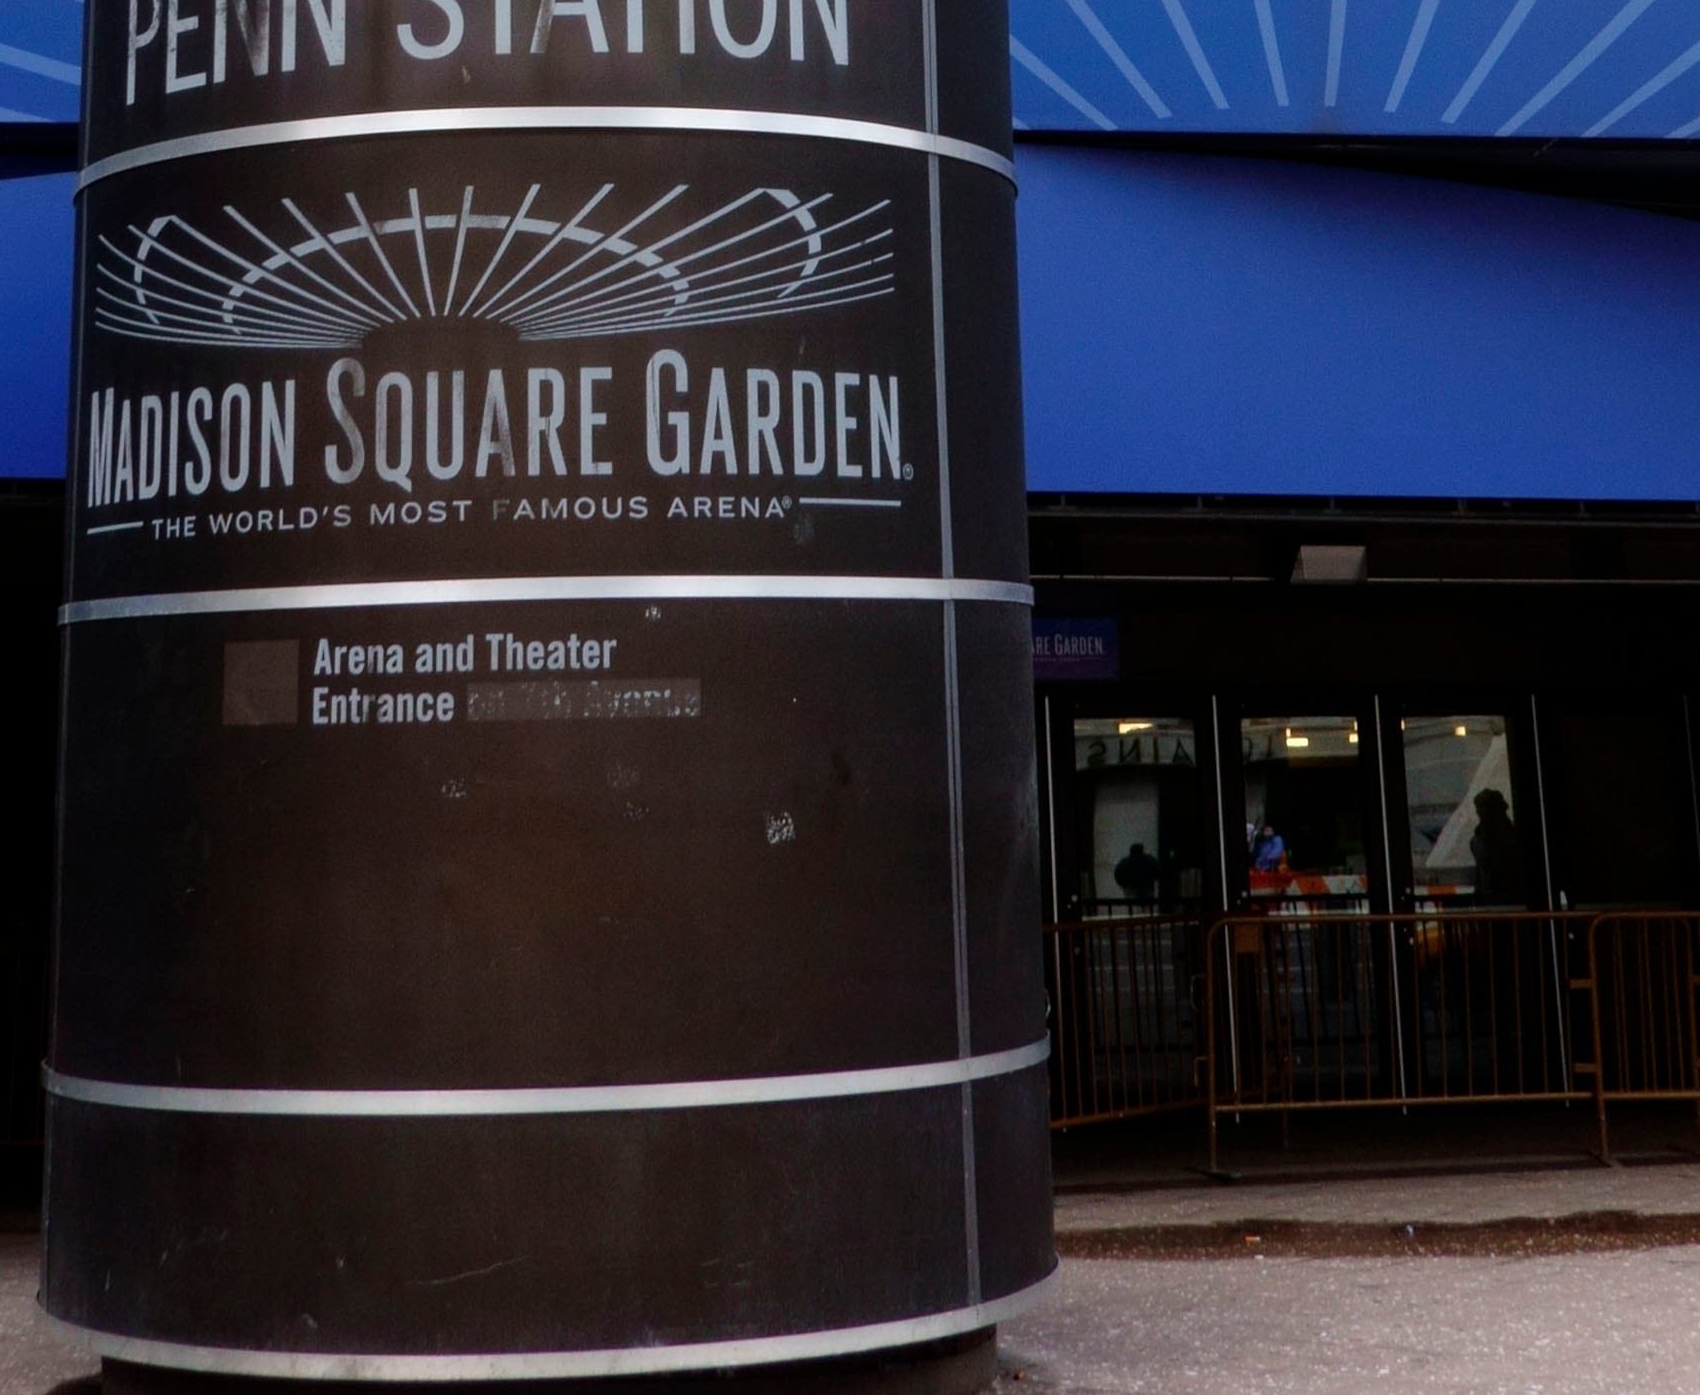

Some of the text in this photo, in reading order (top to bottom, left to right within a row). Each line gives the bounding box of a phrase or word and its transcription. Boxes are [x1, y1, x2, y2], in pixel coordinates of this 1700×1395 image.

[87, 379, 296, 508] MADISON
[326, 357, 613, 489] SQUARE
[151, 515, 197, 540] THE
[209, 505, 352, 535] WORLD'S
[370, 499, 473, 526] MOST
[492, 496, 648, 521] FAMOUS
[313, 633, 617, 675] Arena and Theater
[313, 688, 455, 724] Entrance
